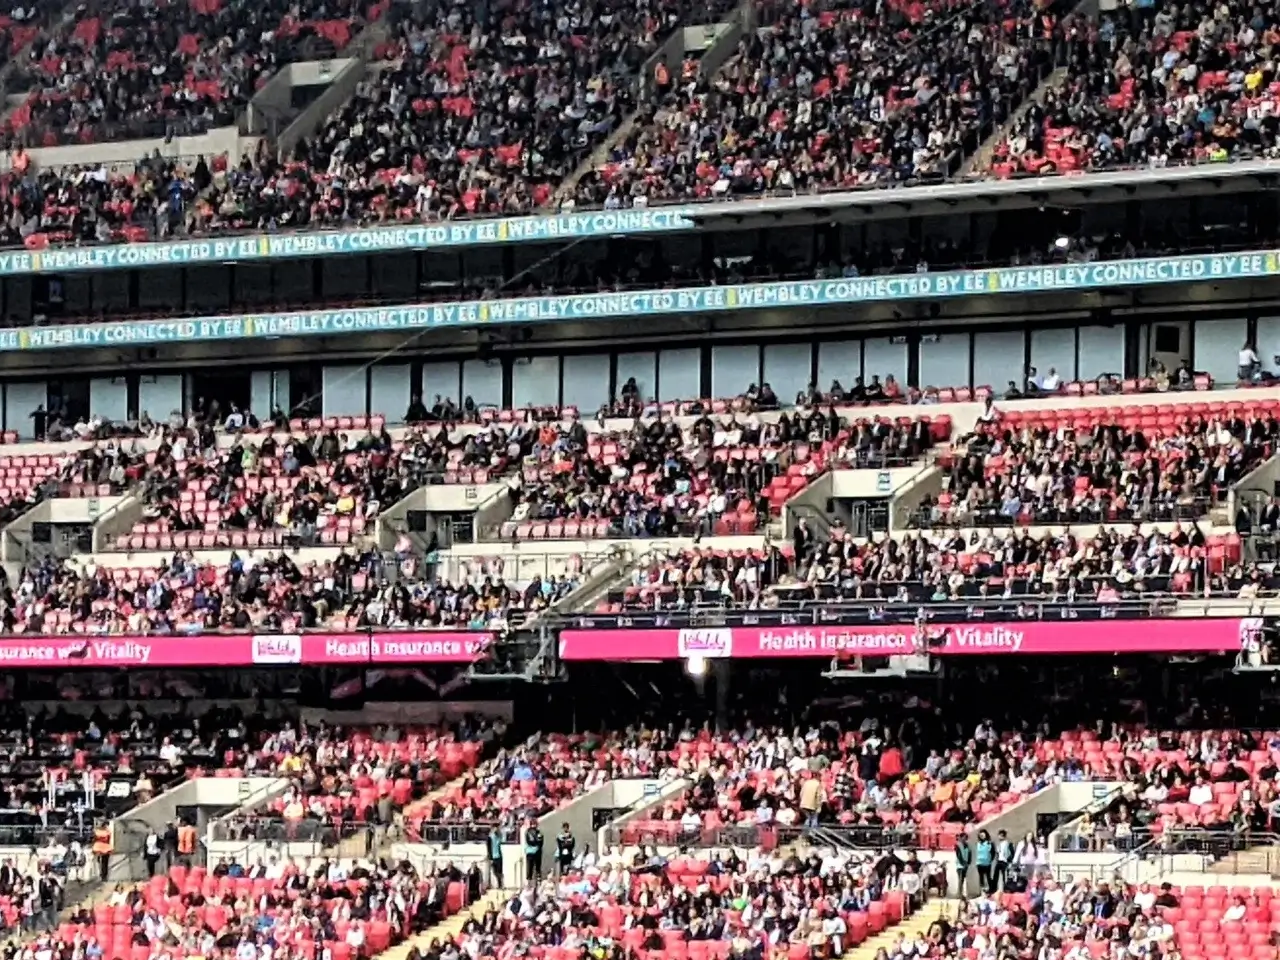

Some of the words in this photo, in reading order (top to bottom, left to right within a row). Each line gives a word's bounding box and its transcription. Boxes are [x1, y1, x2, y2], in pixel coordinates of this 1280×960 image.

[269, 234, 346, 253] WEMBLEY
[350, 227, 446, 248] CONNECTED
[451, 225, 471, 241] BY
[507, 217, 587, 237] WEMBLEY
[42, 250, 116, 269] WEMBLEY
[118, 244, 209, 264] CONNECTED
[214, 242, 234, 257] BY
[1000, 269, 1088, 289] WEMBLEY
[1092, 262, 1204, 283] CONNECTED
[1210, 260, 1234, 276] BY
[738, 285, 820, 304] WEMBLEY
[825, 278, 930, 299] CONNECTED
[936, 277, 960, 293] BY
[490, 301, 568, 319] WEMBLEY
[572, 294, 672, 314] CONNECTED
[678, 293, 700, 308] BY
[255, 315, 330, 333] WEMBLEY
[333, 309, 428, 329] CONNECTED
[434, 308, 452, 323] BY
[30, 329, 102, 346] WEMBLEY
[104, 323, 194, 342] CONNECTED
[200, 322, 220, 337] BY
[325, 638, 379, 657] Health
[383, 639, 461, 656] insurance
[759, 631, 815, 649] Health
[820, 631, 905, 649] insurance
[955, 626, 1024, 650] Vitality
[96, 642, 151, 664] Vitality
